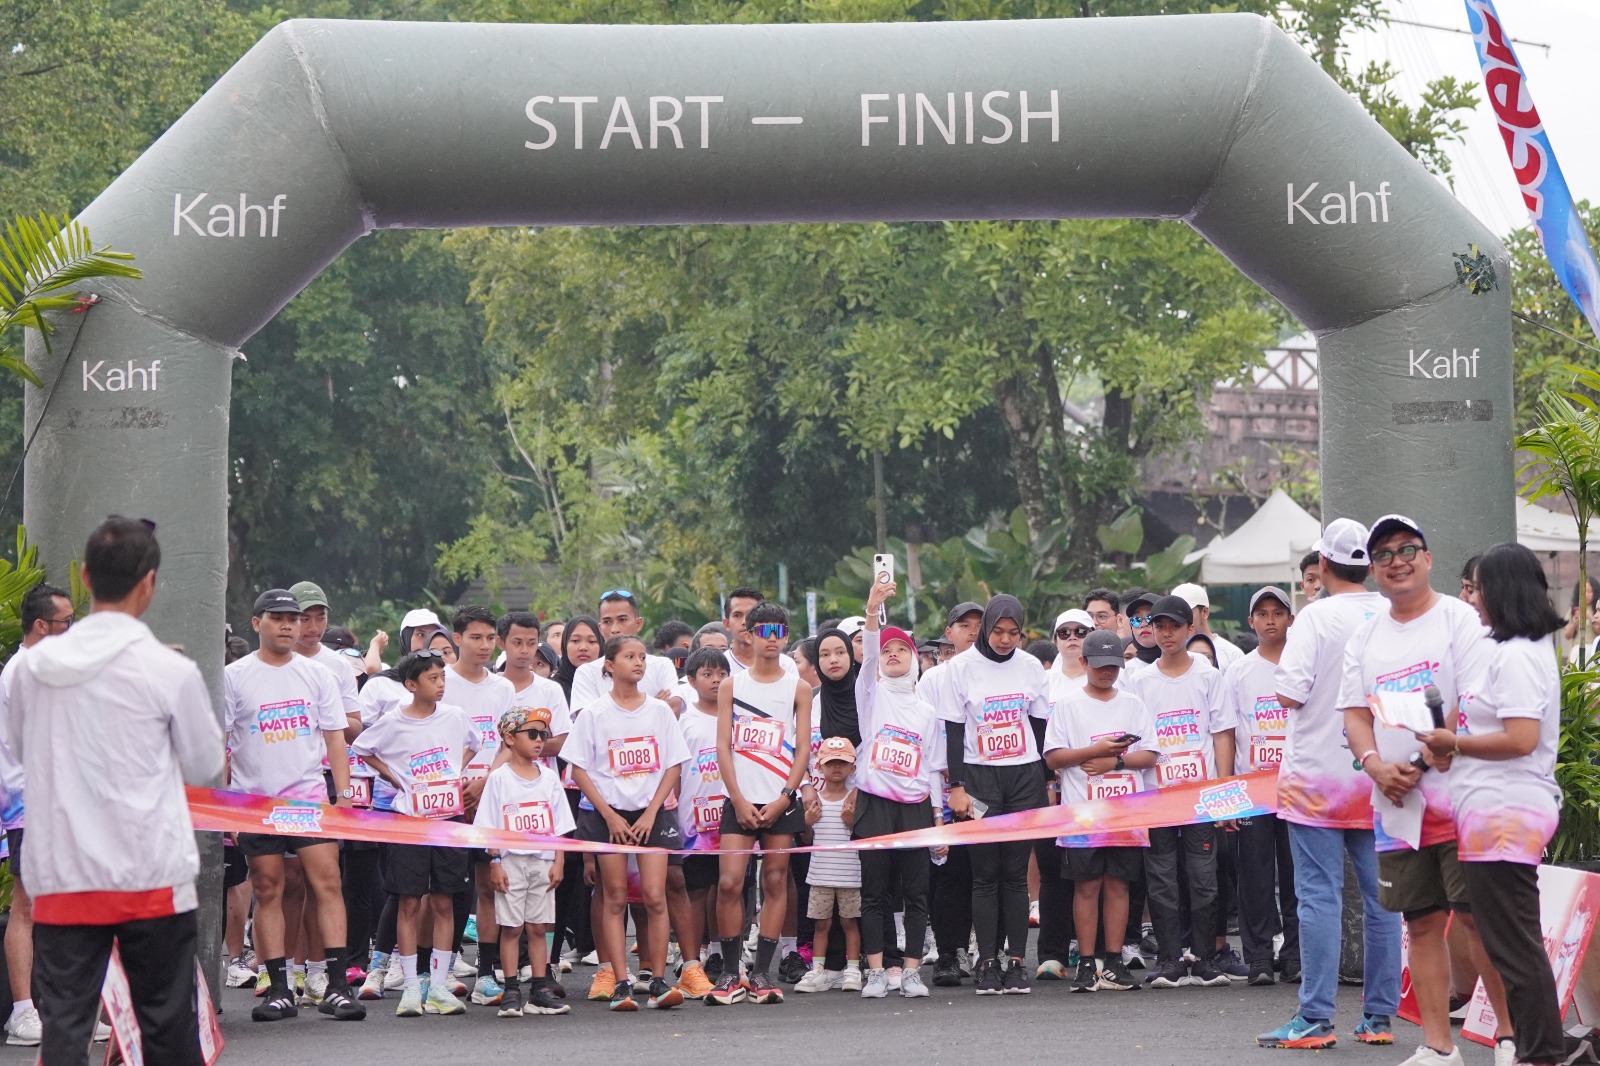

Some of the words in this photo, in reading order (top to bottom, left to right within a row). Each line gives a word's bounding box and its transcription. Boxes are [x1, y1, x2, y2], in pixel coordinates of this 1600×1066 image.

[525, 96, 723, 151] START
[861, 90, 1060, 147] FINISH
[1287, 180, 1392, 225] Kahf
[173, 193, 287, 238] Kahf
[1408, 348, 1480, 379] Kahf
[82, 360, 161, 392] Kahf
[257, 706, 307, 721] COLOR
[983, 698, 1024, 712] COLOR
[1255, 700, 1283, 711] COL
[1155, 714, 1197, 729] COLOR
[1255, 709, 1288, 721] WATE
[259, 716, 310, 733] WATER
[1156, 724, 1200, 737] WATER
[1258, 719, 1287, 731] RUN
[263, 729, 297, 744] RUN
[743, 727, 774, 747] 0281
[987, 733, 1019, 752] 0260
[1158, 735, 1187, 748] RUN
[409, 751, 446, 768] COLOR
[619, 748, 651, 766] 0088
[881, 746, 913, 768] 0350
[1260, 748, 1283, 763] 025
[411, 759, 452, 777] WATER
[1166, 762, 1198, 781] 0253
[702, 771, 721, 783] RU
[422, 792, 455, 810] 0278
[1201, 787, 1243, 804] COLOR
[1204, 794, 1248, 810] WATER
[515, 814, 546, 830] 0051
